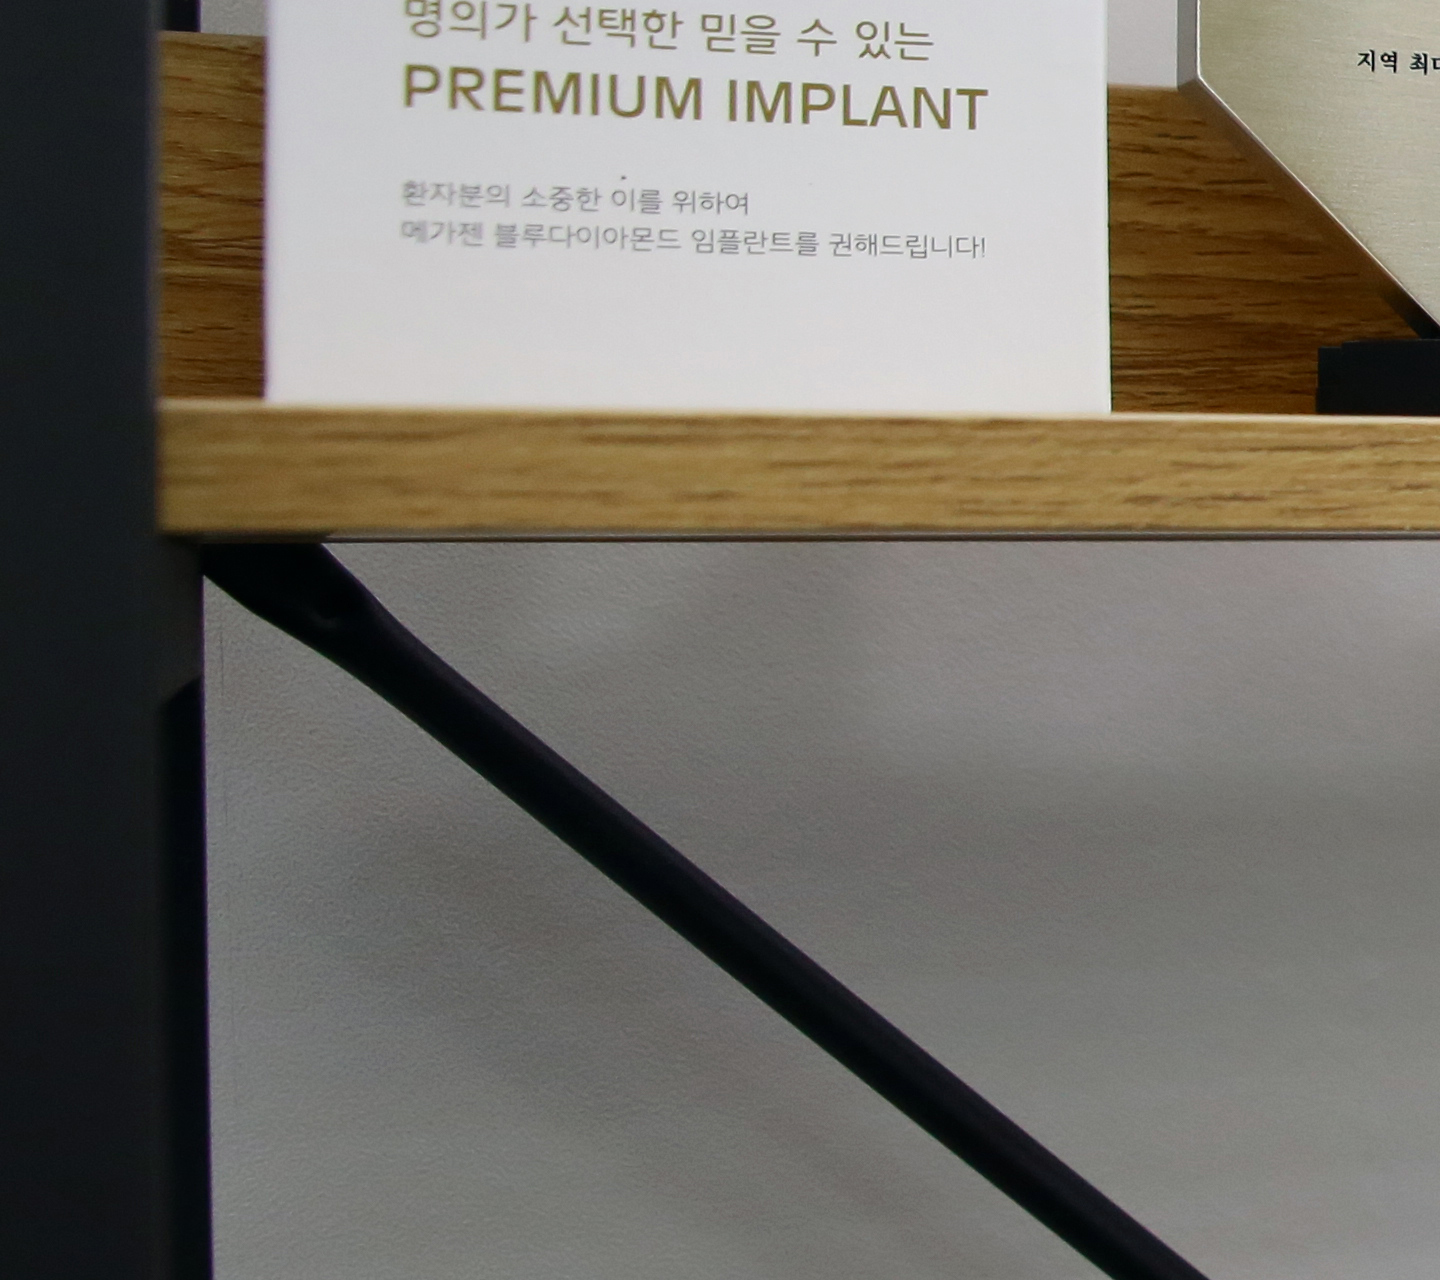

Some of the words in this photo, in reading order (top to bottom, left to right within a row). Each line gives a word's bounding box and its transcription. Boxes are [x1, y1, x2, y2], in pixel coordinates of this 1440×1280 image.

[553, 6, 684, 51] 선택한
[700, 13, 781, 55] 믿을
[796, 18, 838, 57] 수
[855, 20, 934, 61] 있는
[404, 63, 702, 121] PREMIUM
[728, 79, 989, 131] IMPLANT
[402, 180, 510, 208] 환자분의
[522, 185, 602, 213] 소중한
[610, 188, 663, 215] 이를
[672, 190, 749, 216] 위하여
[400, 220, 484, 248] 메가젠
[494, 223, 682, 253] 블루다이아몬드
[691, 229, 820, 257] 임플란트를
[828, 232, 986, 260] 권해드립니다!
